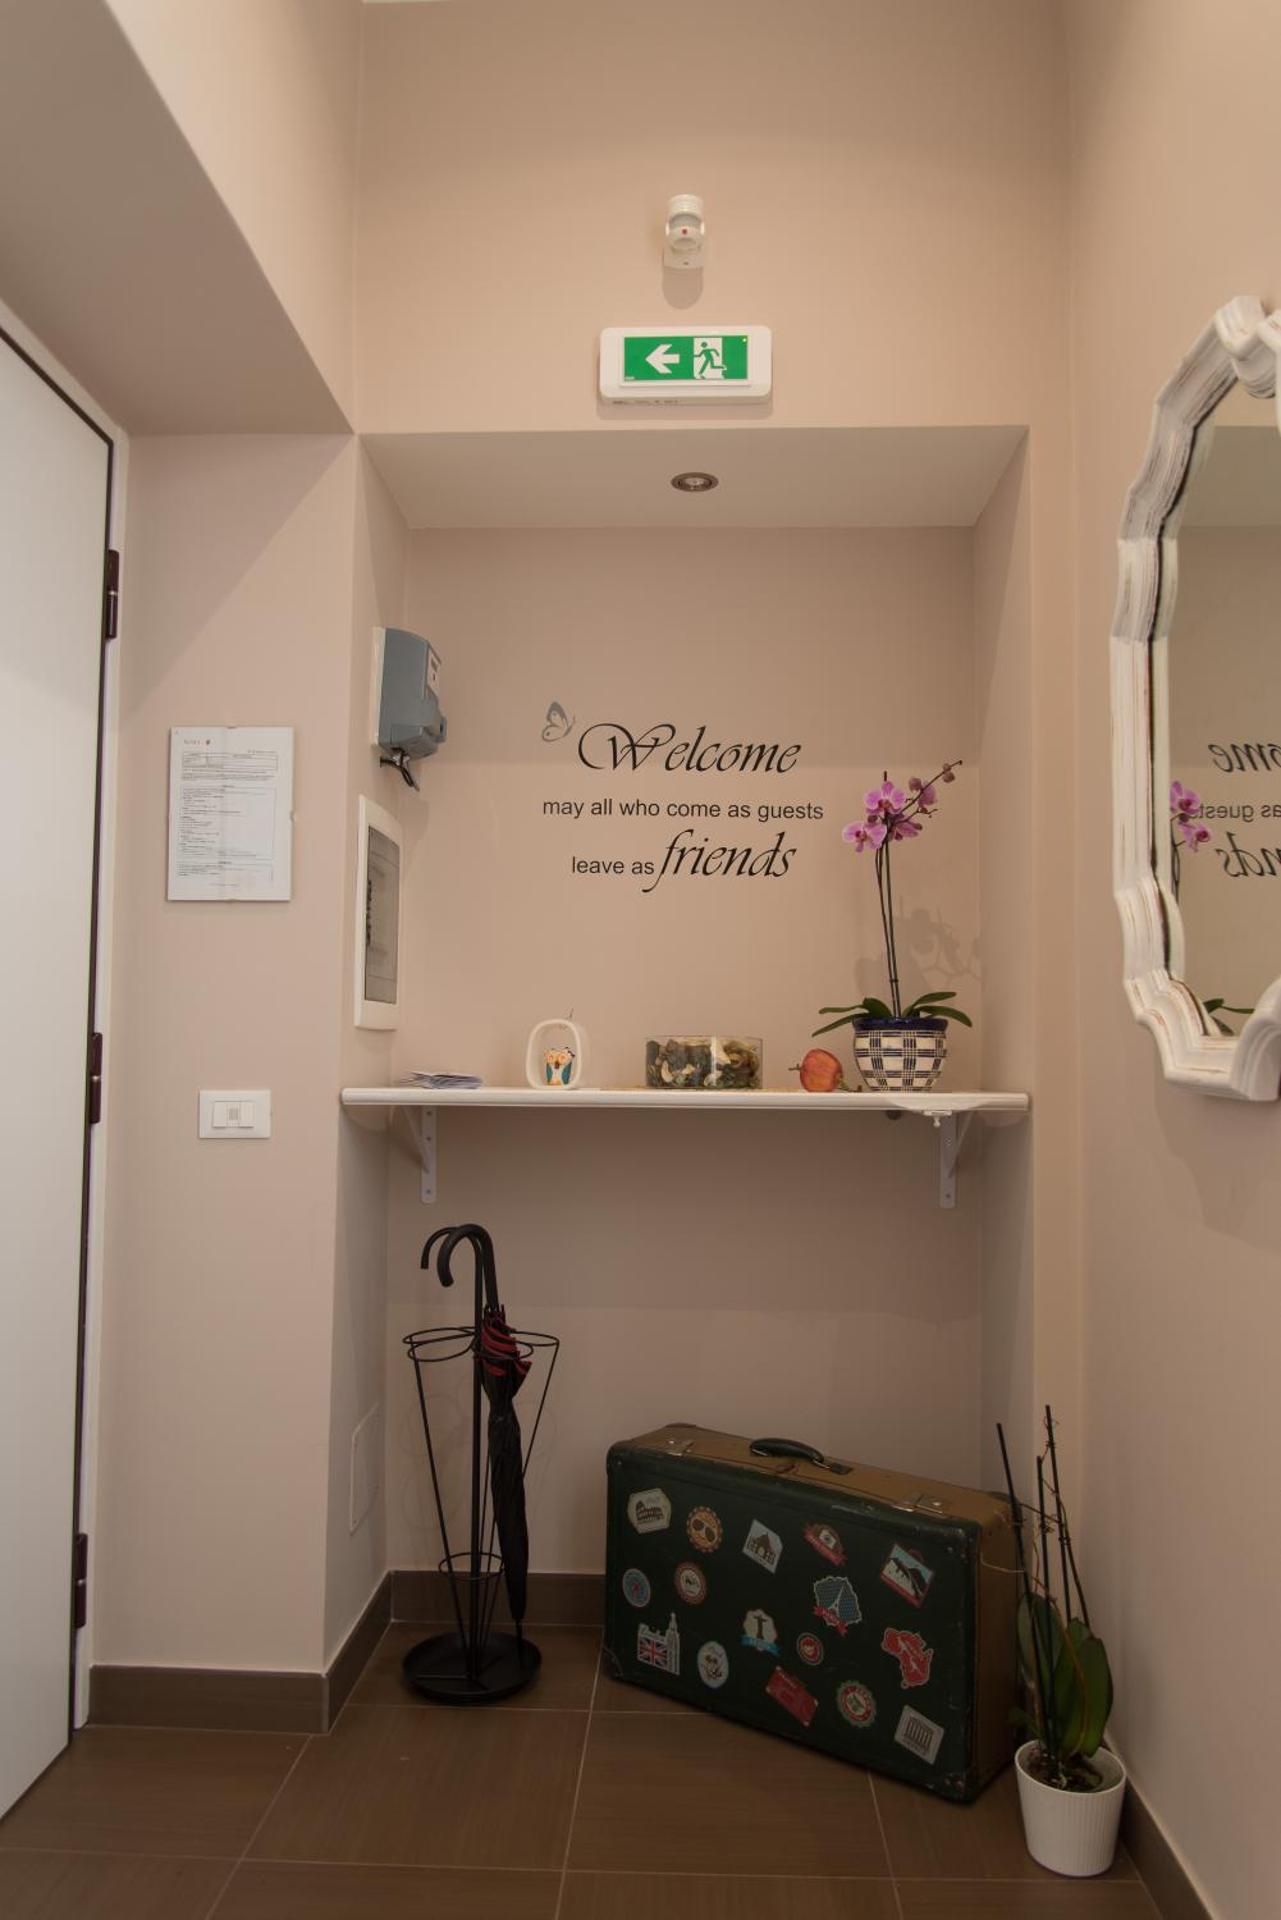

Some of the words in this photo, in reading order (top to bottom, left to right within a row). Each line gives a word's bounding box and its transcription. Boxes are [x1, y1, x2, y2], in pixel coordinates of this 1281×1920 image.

[578, 723, 802, 774] Welcome
[543, 801, 585, 820] may
[591, 797, 613, 816] all
[618, 798, 661, 817] who
[665, 803, 721, 818] come
[727, 805, 751, 819] as
[757, 803, 824, 823] guests
[571, 855, 625, 875] leave
[631, 860, 656, 876] as
[641, 828, 798, 893] friends
